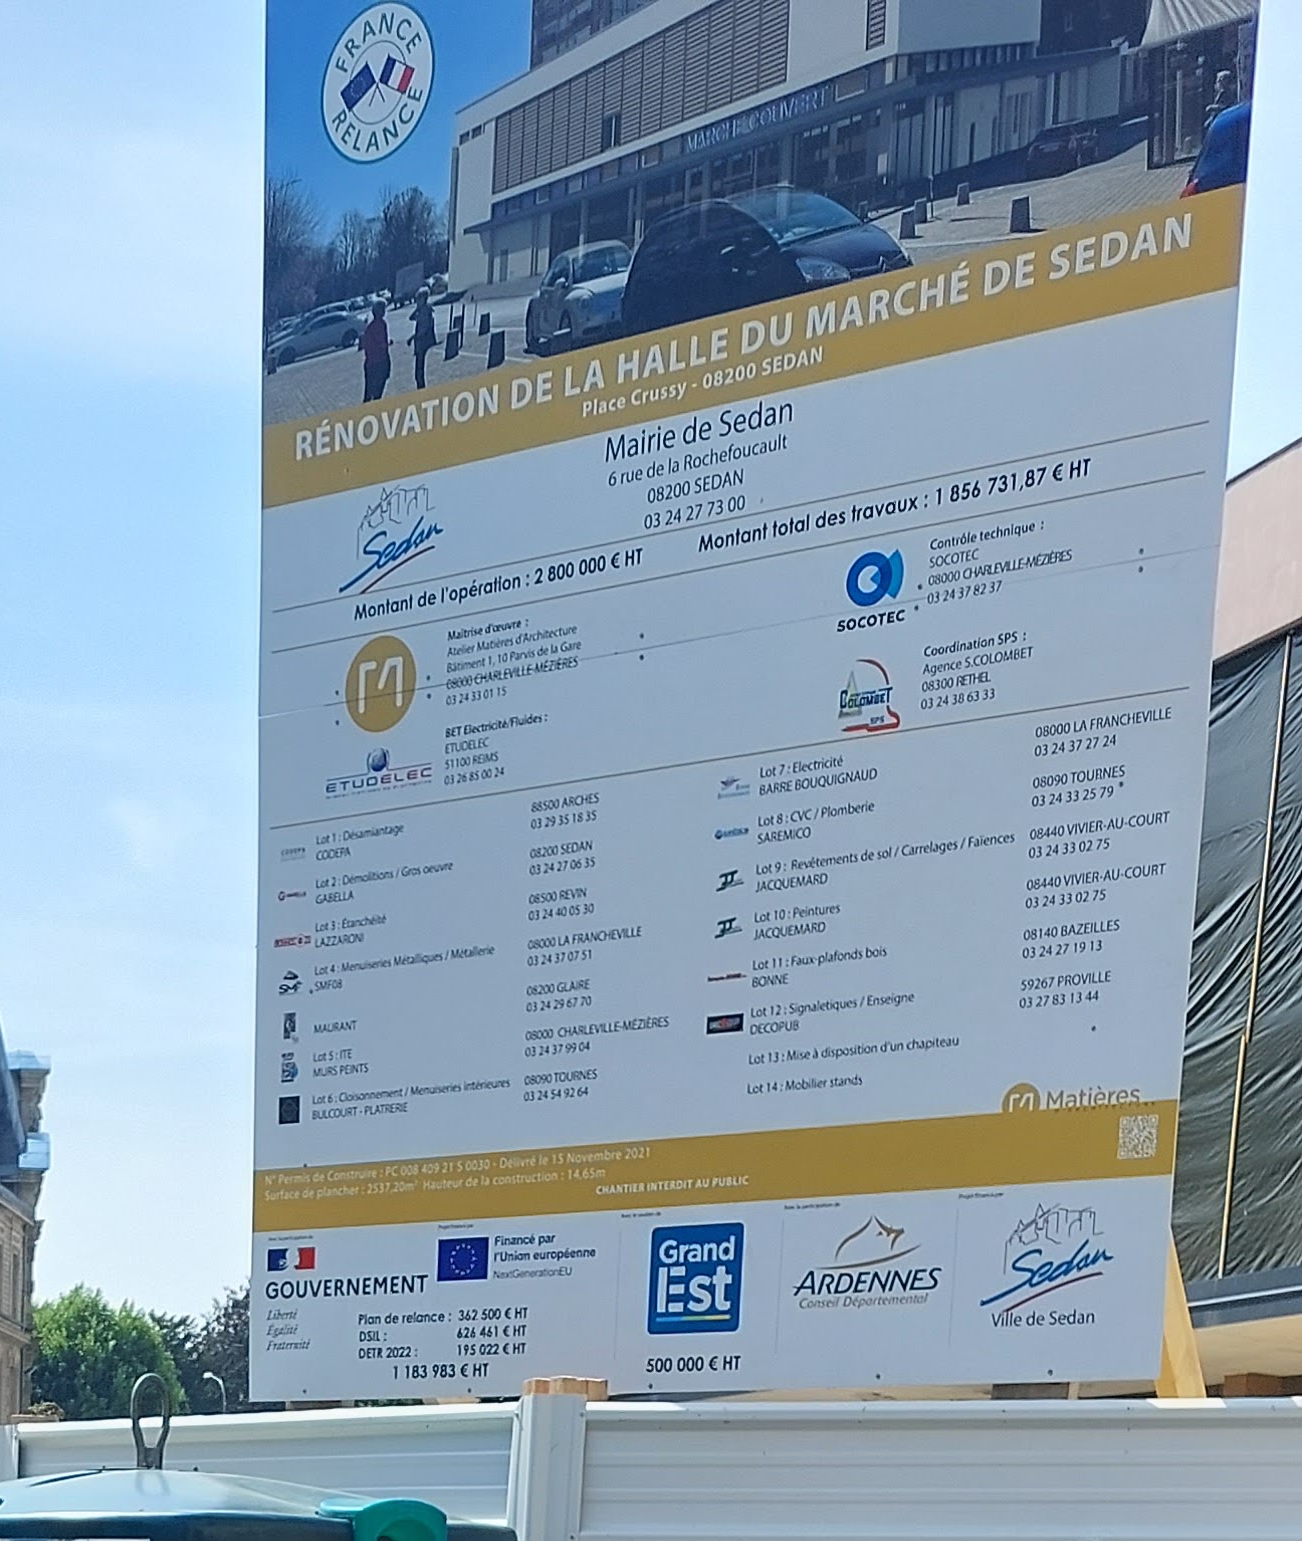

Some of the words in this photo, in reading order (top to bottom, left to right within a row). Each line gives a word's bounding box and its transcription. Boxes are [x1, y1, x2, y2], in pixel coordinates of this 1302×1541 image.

[336, 12, 422, 74] FRANCE
[332, 86, 423, 154] RELANCE
[295, 383, 498, 461] RÉNOVATION
[510, 369, 553, 410] DE
[564, 358, 605, 398] LA
[616, 326, 728, 384] HALLE
[740, 310, 794, 355] DU
[805, 260, 969, 340] MARCHÉ
[983, 251, 1035, 297] DE
[1049, 212, 1193, 280] SEDAN
[582, 394, 626, 418] Place
[631, 380, 687, 406] Crussy
[702, 364, 756, 390] 08200
[761, 346, 824, 377] SEDAN
[605, 425, 676, 462] Mairie
[682, 415, 712, 445] de
[719, 400, 793, 438] Sedan
[608, 471, 617, 487] 6
[620, 466, 643, 485] rue
[646, 460, 665, 480] de
[668, 456, 680, 474] la
[683, 433, 788, 472] Rochefoucault
[647, 481, 691, 504] 08200
[694, 468, 745, 495] SEDAN
[698, 522, 768, 553] Montant
[772, 513, 810, 538] total
[815, 507, 846, 529] des
[851, 494, 920, 523] travaux
[935, 486, 943, 506] 1
[949, 478, 982, 503] 856
[987, 465, 1048, 498] 731,87
[1052, 462, 1065, 482] €
[1068, 456, 1091, 480] HT
[929, 530, 977, 551] Contrôle
[979, 520, 1036, 544] technique
[338, 516, 444, 593] Sedan
[929, 548, 979, 569] SOCOTEC
[354, 596, 414, 622] Montant
[417, 590, 437, 609] de
[441, 570, 523, 608] l'opération
[534, 567, 544, 586] 2
[547, 559, 575, 582] 800
[579, 553, 607, 576] 000
[610, 550, 623, 570] €
[625, 547, 644, 568] HT
[927, 570, 961, 587] 08000
[836, 609, 906, 633] SOCOTEC
[923, 636, 995, 659] Coordination
[998, 630, 1018, 647] SPS
[922, 658, 962, 678] Agence
[964, 646, 1033, 669] S.COLOMBET
[921, 677, 954, 693] 08300
[955, 671, 992, 688] RETHEL
[1035, 722, 1071, 739] 08000
[1073, 719, 1087, 734] LA
[1089, 706, 1172, 731] FRANCHEVILLE
[792, 754, 844, 775] Electricité
[325, 766, 433, 794] ETUDELEC
[758, 778, 793, 797] BARRE
[1032, 773, 1068, 790] 08090
[1071, 764, 1126, 785] TOURNES
[820, 800, 875, 820] Plomberie
[1029, 825, 1065, 841] 08440
[1067, 810, 1171, 836] VIVIER-AU-COURT
[790, 852, 859, 872] Revêtements
[901, 837, 958, 858] Carrelages
[755, 871, 829, 894] JACQUEMARD
[1026, 876, 1061, 892] 08440
[1063, 862, 1167, 887] VIVIER-AU-COURT
[792, 904, 841, 920] Peintures
[1023, 926, 1058, 942] 08140
[1060, 919, 1120, 938] BAZEILLES
[790, 946, 863, 968] Faux-plafonds
[1021, 976, 1055, 991] 59267
[1057, 969, 1112, 988] PROVILLE
[866, 991, 915, 1009] Enseigne
[830, 1073, 863, 1088] stands
[1047, 1085, 1141, 1110] Matières
[596, 1182, 645, 1195] CHANTIER
[647, 1179, 693, 1193] INTERDIT
[695, 1178, 709, 1188] AU
[711, 1175, 750, 1188] PUBLIC
[495, 1234, 536, 1247] Financé
[538, 1234, 556, 1247] par
[659, 1235, 735, 1265] Grand
[494, 1249, 530, 1263] l'Union
[533, 1247, 596, 1262] européenne
[793, 1268, 942, 1296] ARDENNES
[980, 1239, 1114, 1306] Sedan
[265, 1273, 428, 1300] GOUVERNEMENT
[656, 1265, 732, 1313] Est
[799, 1295, 838, 1309] Conseil
[843, 1292, 929, 1310] Départemental
[266, 1307, 298, 1322] Liberté
[358, 1312, 381, 1326] Plan
[384, 1311, 399, 1324] de
[402, 1310, 445, 1324] relance
[458, 1308, 479, 1322] 362
[482, 1307, 502, 1321] 500
[505, 1307, 512, 1320] €
[514, 1306, 528, 1319] HT
[991, 1311, 1022, 1328] Ville
[1026, 1310, 1045, 1327] de
[1049, 1309, 1095, 1325] Sedan
[456, 1325, 477, 1339] 626
[479, 1324, 499, 1338] 461
[502, 1324, 510, 1337] €
[513, 1324, 526, 1337] HT
[358, 1346, 382, 1360] DETR
[385, 1345, 412, 1359] 2022
[457, 1343, 476, 1357] 195
[478, 1342, 499, 1356] 022
[502, 1342, 510, 1355] €
[513, 1342, 526, 1355] HT
[393, 1365, 398, 1380] 1
[404, 1363, 428, 1379] 183
[432, 1362, 456, 1378] 983
[460, 1362, 468, 1377] €
[472, 1362, 489, 1377] HT
[646, 1357, 673, 1373] 500
[677, 1356, 704, 1372] 000
[708, 1356, 718, 1371] €
[723, 1355, 740, 1371] HT
